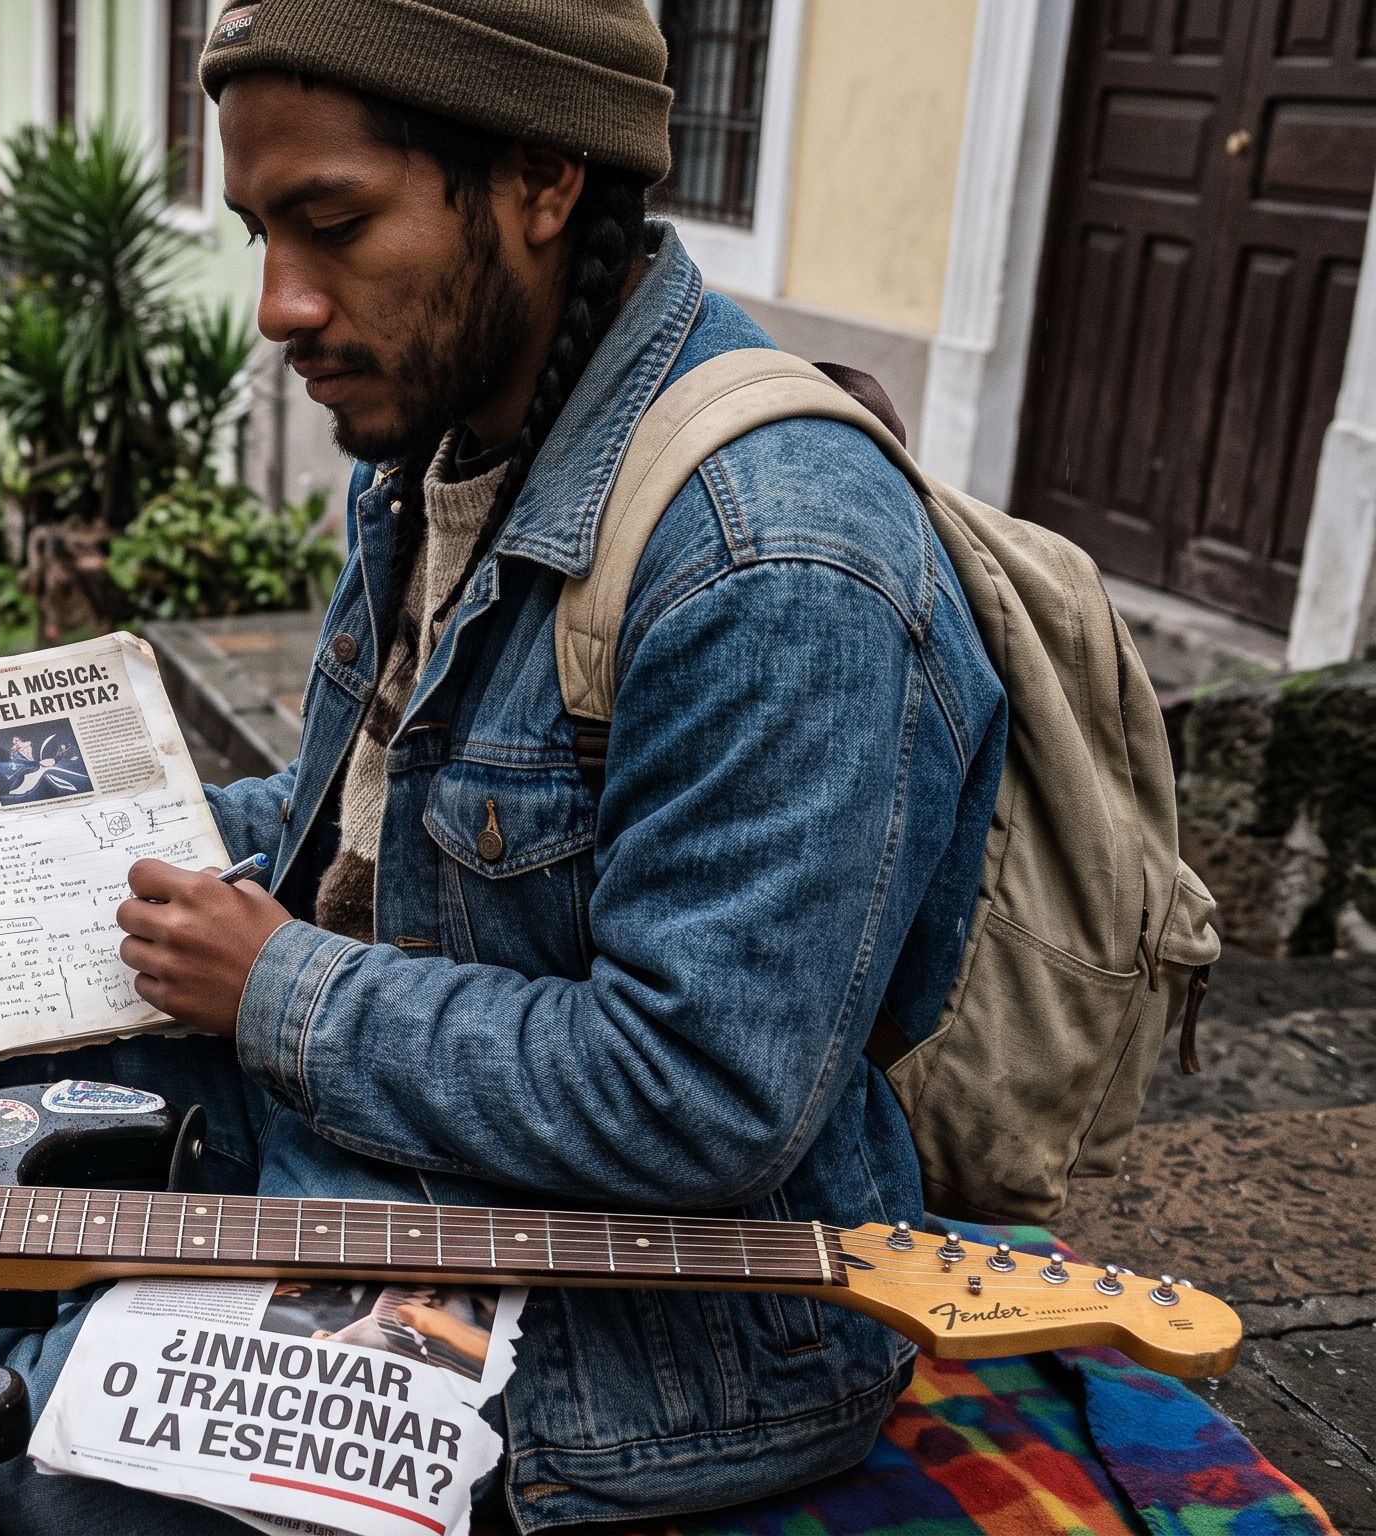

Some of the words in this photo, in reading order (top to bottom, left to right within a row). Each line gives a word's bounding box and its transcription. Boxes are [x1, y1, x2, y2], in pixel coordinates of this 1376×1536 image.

[23, 664, 109, 694] MÚSICA:
[30, 683, 119, 717] ARTISTA?
[928, 1302, 1028, 1330] Fender
[161, 1329, 412, 1401] ¿INNOVAR
[102, 1361, 137, 1397] O
[157, 1367, 462, 1461] TRAICIONAR
[118, 1406, 181, 1451] LA
[199, 1418, 453, 1506] ESENCIA?
